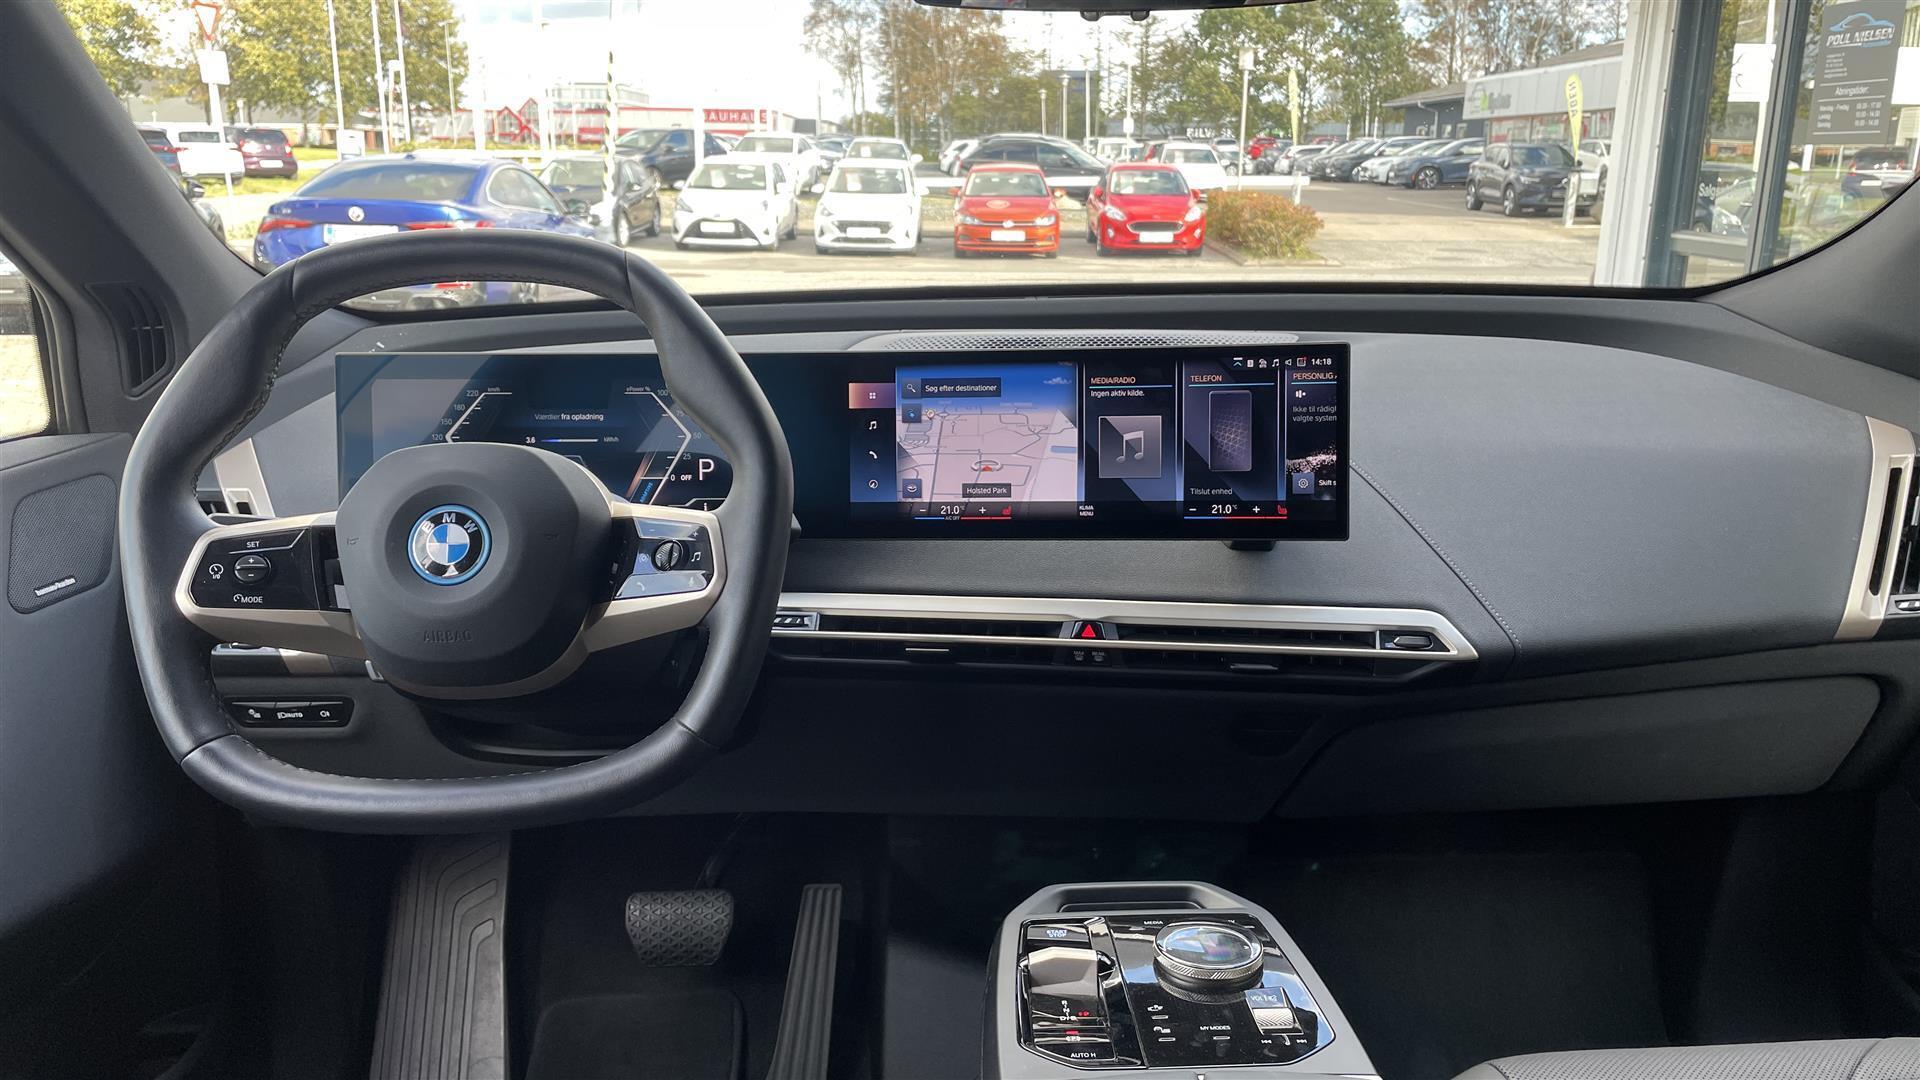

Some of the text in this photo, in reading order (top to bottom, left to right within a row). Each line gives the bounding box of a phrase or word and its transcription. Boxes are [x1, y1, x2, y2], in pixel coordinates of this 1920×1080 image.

[1852, 25, 1896, 42] NIELSEN
[1311, 358, 1332, 366] 14:18
[1090, 376, 1137, 384] MEDIA/RADIO
[1190, 374, 1223, 382] TELEFON
[1293, 372, 1334, 380] PERSONLIG
[925, 384, 997, 393] Søg efter destinationer
[657, 389, 668, 397] 100
[1090, 389, 1145, 398] Ingen aktiv kilde.
[1293, 405, 1307, 413] Ikke
[1308, 405, 1316, 413] til
[561, 413, 570, 421] fra
[571, 413, 604, 422] opladning
[1293, 415, 1314, 423] valgte
[698, 458, 715, 481] P
[966, 486, 1008, 495] Holsted Park
[1190, 487, 1233, 495] Tilslut enhed
[421, 513, 478, 539] BMW
[241, 596, 263, 604] MODE
[423, 629, 474, 644] AIRBAG
